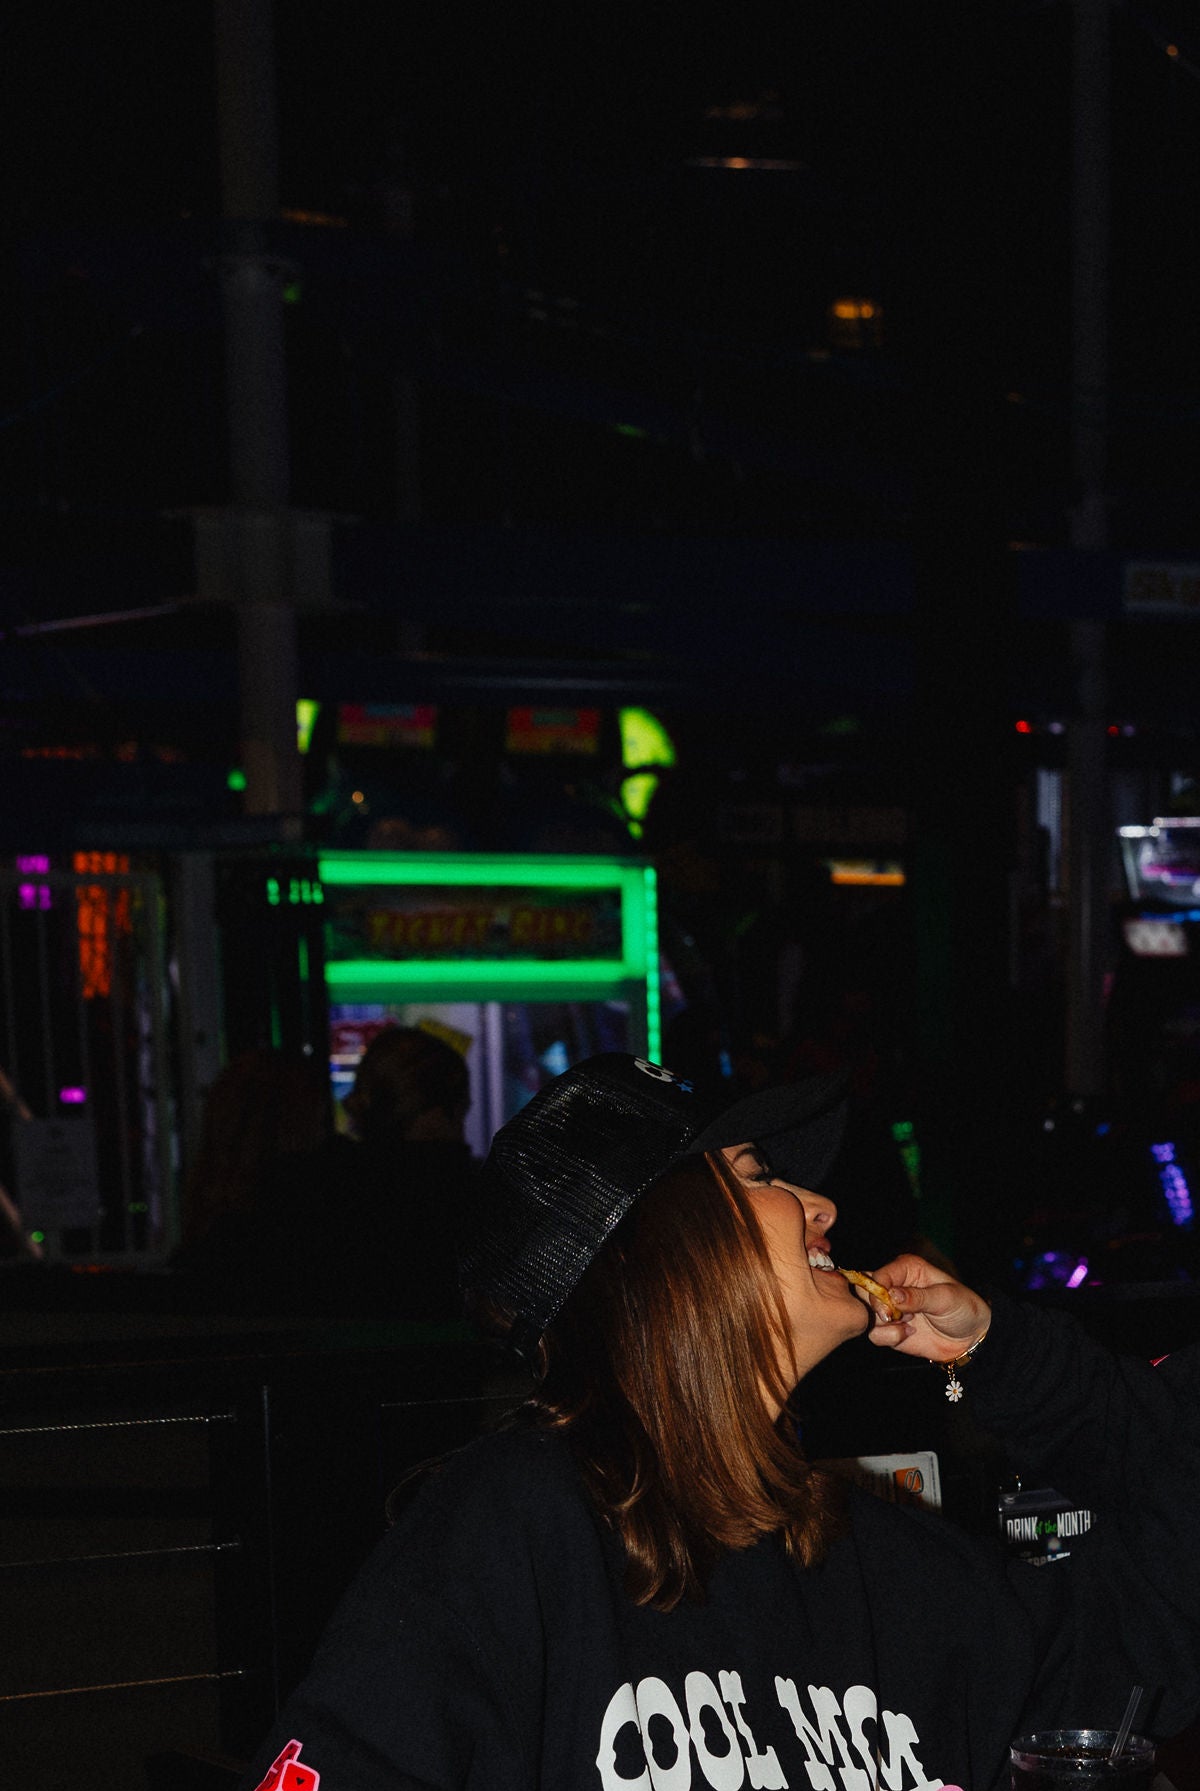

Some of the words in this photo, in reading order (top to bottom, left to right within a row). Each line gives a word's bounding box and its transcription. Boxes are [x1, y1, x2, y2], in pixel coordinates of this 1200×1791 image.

[1006, 1516, 1039, 1545] DRINK
[1044, 1519, 1057, 1535] the
[1057, 1510, 1092, 1538] MONTH
